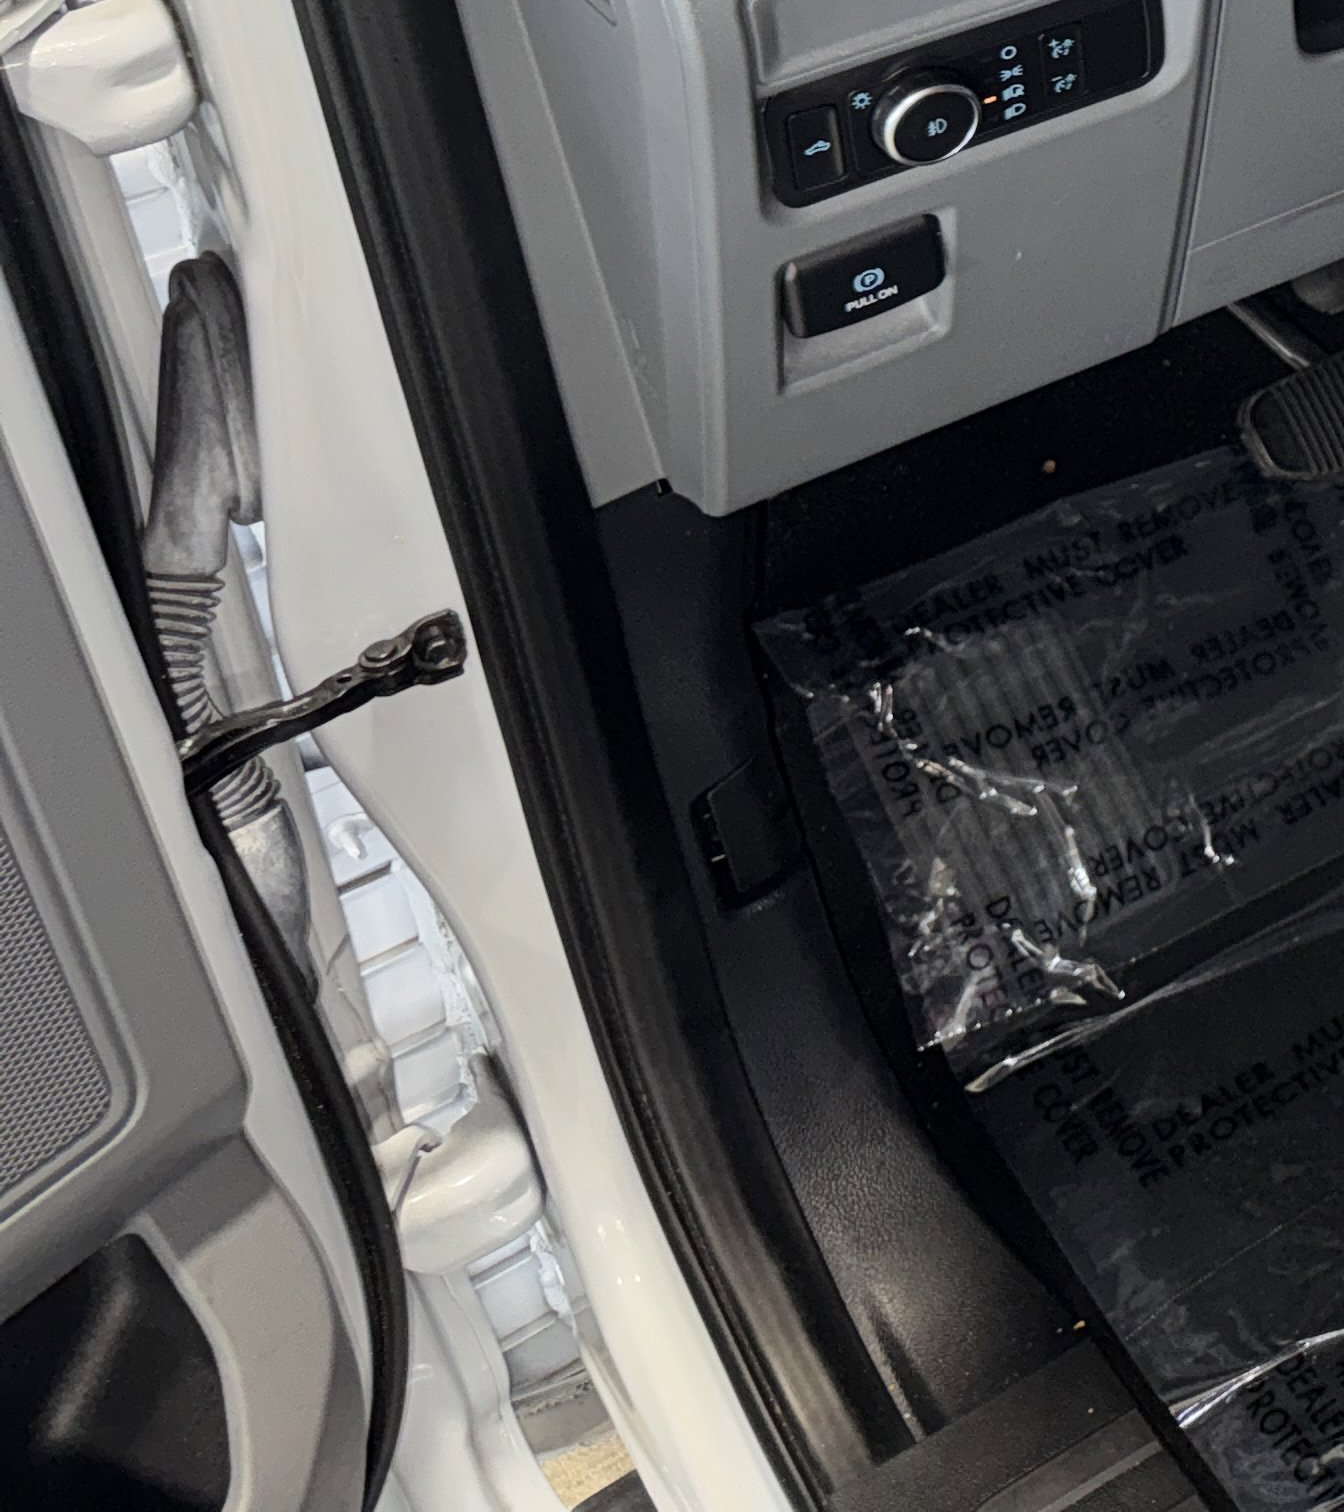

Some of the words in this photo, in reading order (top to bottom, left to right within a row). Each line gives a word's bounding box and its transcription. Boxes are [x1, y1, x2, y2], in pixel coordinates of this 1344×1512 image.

[845, 294, 878, 313] PULL
[877, 284, 899, 300] ON
[1022, 530, 1101, 580] MUST
[1115, 480, 1238, 544] REMOVE
[1092, 533, 1189, 588] COVER
[1150, 1061, 1276, 1143] DEALER
